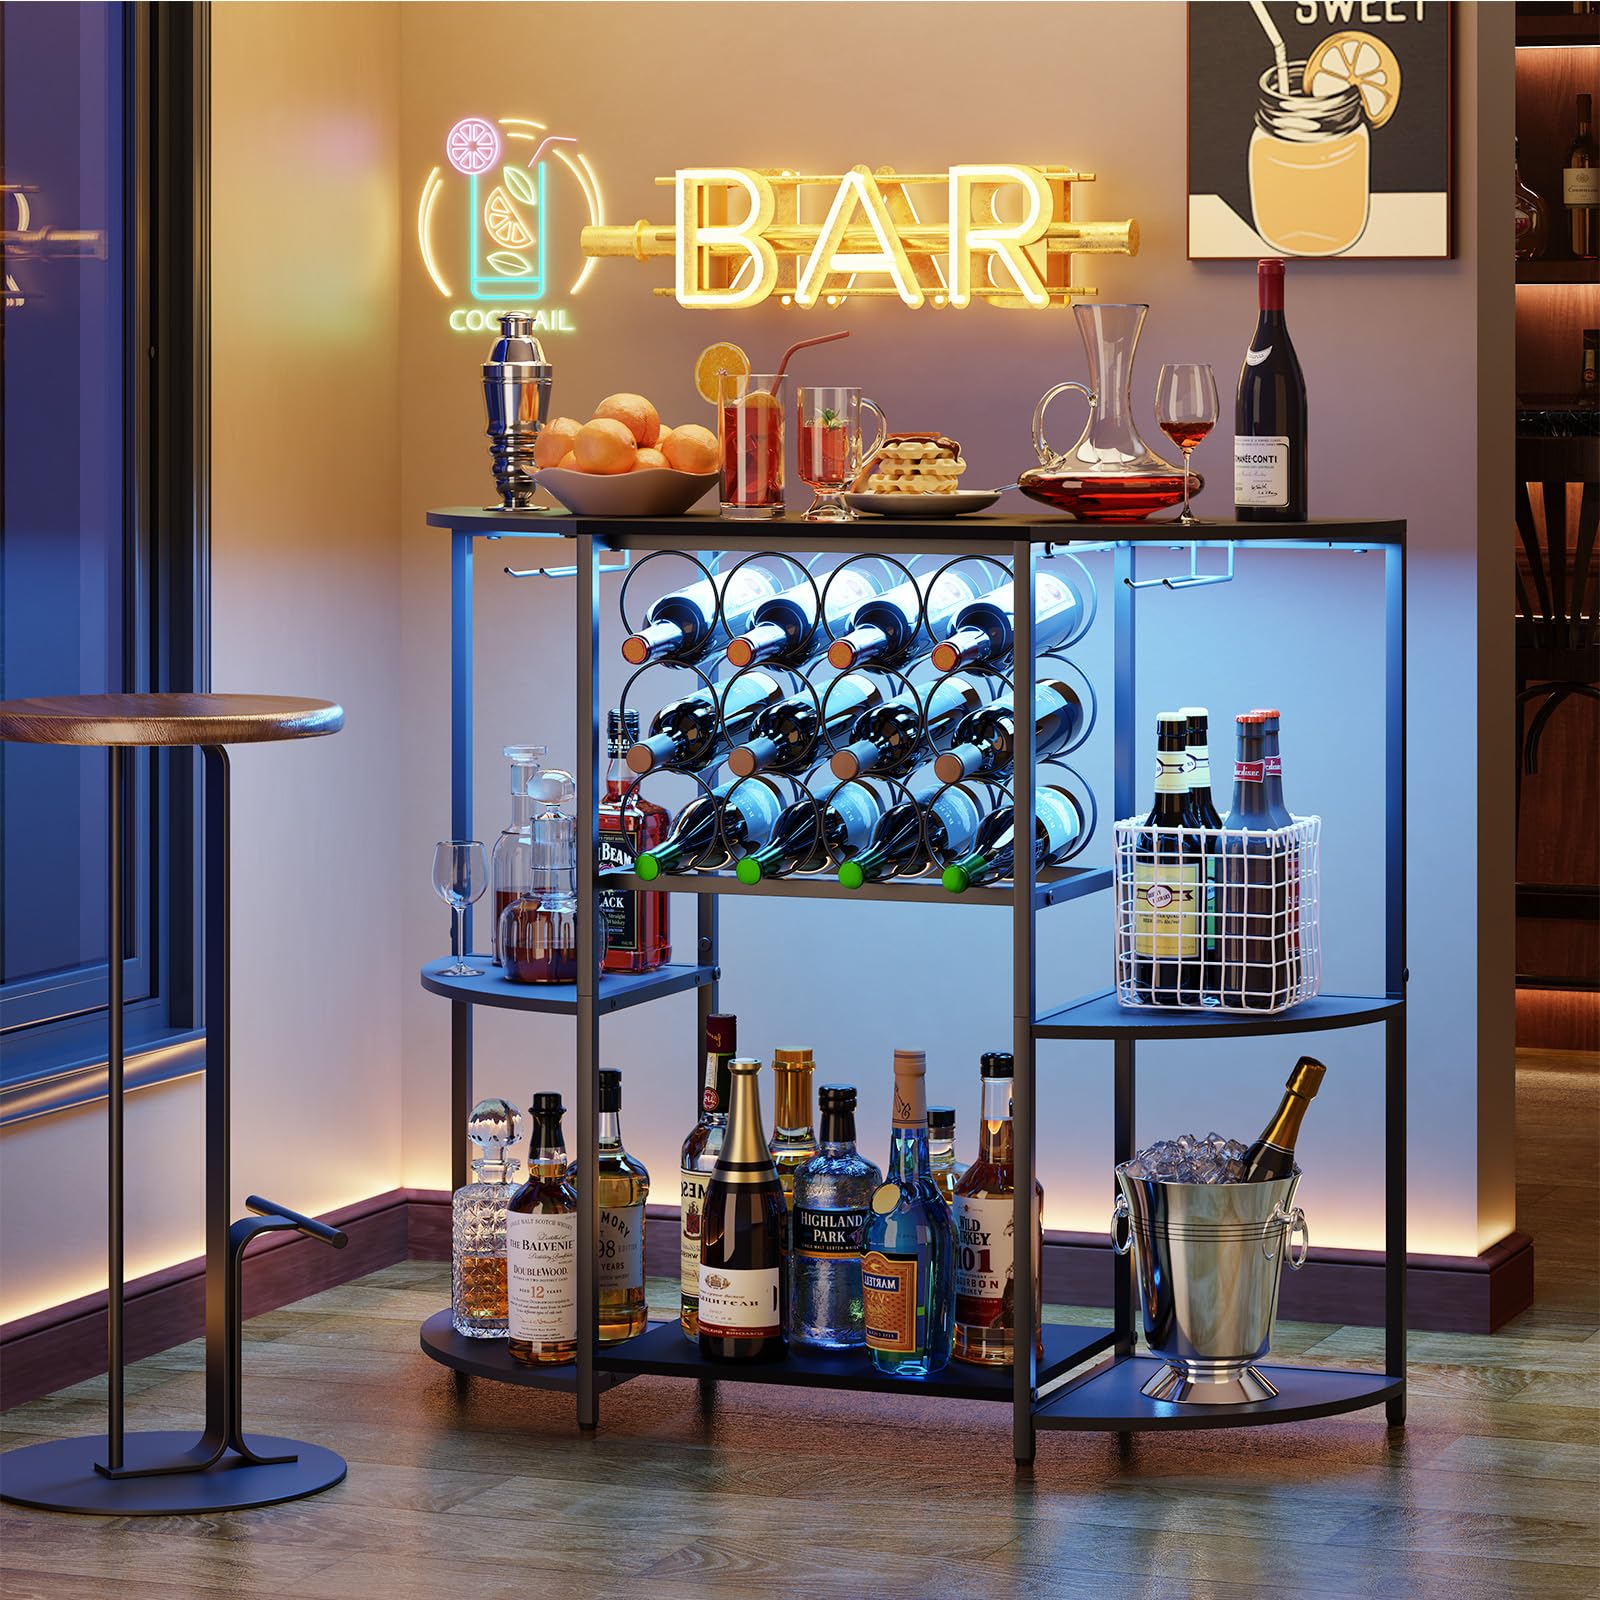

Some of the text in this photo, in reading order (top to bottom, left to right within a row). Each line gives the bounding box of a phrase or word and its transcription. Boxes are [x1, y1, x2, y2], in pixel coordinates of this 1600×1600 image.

[675, 165, 1052, 310] BAR
[448, 308, 577, 332] COCAIL
[602, 842, 633, 867] BEAM
[600, 896, 625, 909] ACK
[535, 1218, 556, 1226] SCOTCH
[800, 1211, 863, 1228] HIGHLAND
[959, 1215, 981, 1232] WILD
[813, 1229, 846, 1243] PARK
[510, 1238, 573, 1252] THE BALVENIE
[601, 1262, 625, 1271] YEARS
[530, 1285, 545, 1299] 12
